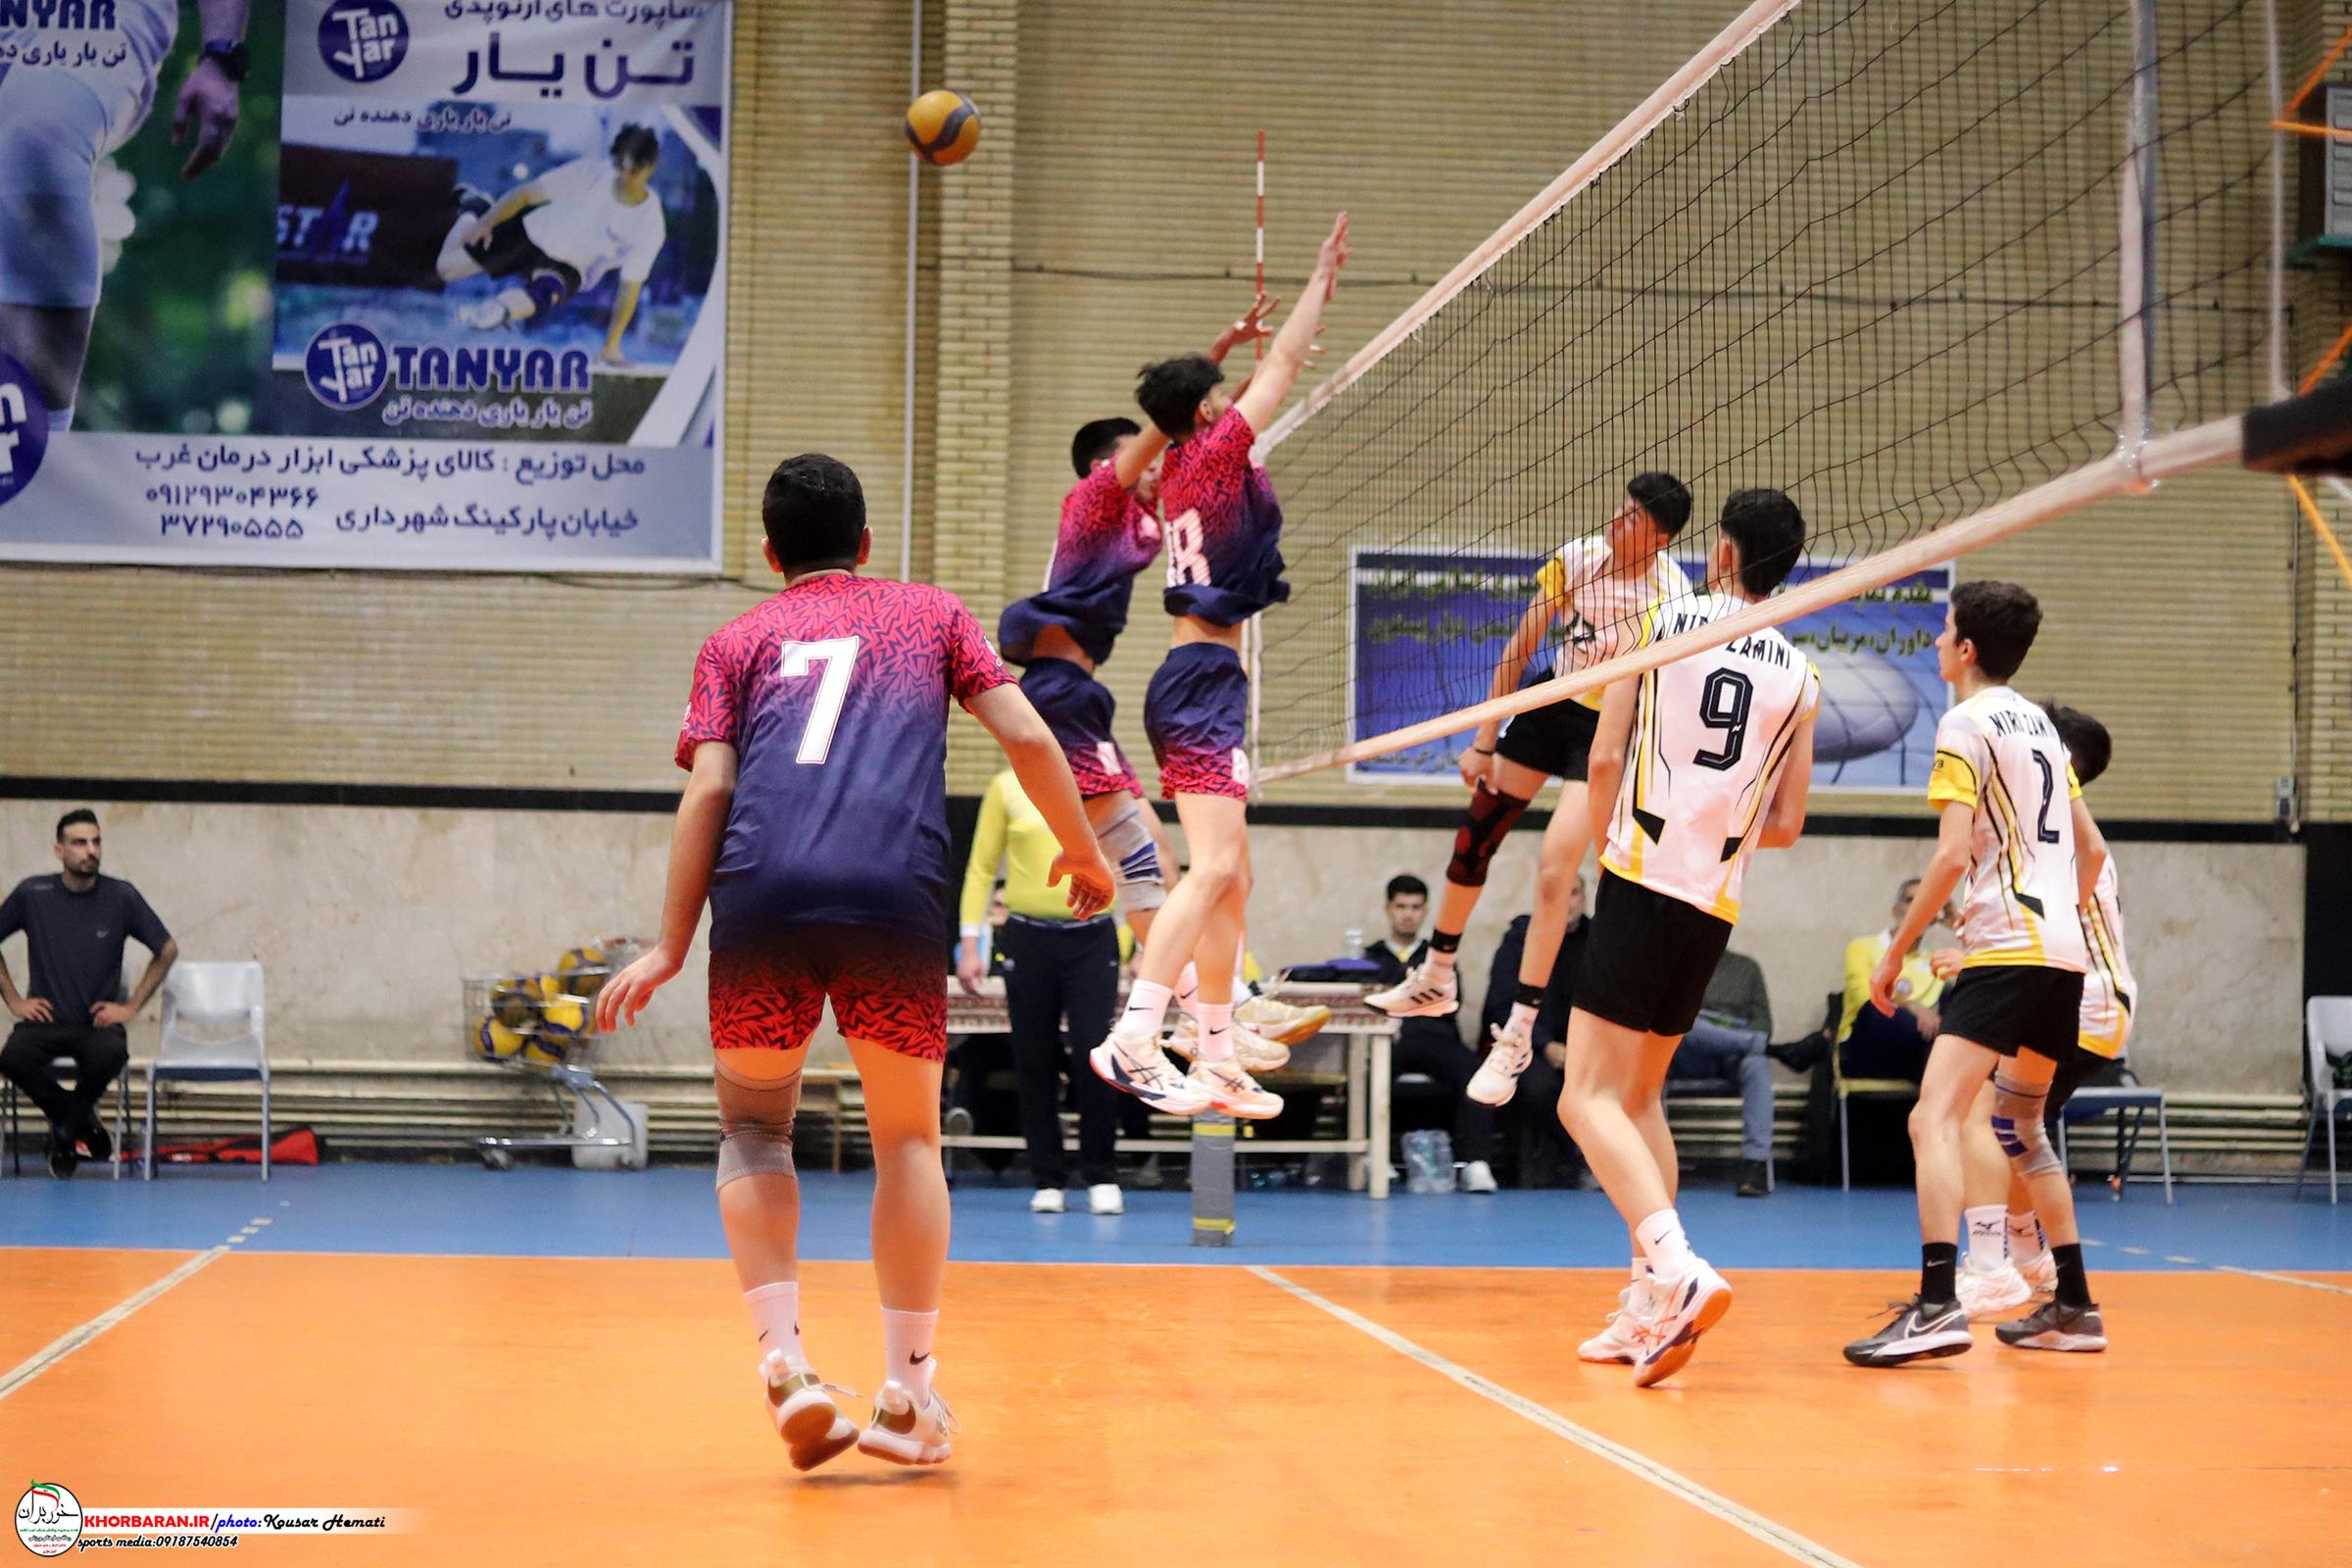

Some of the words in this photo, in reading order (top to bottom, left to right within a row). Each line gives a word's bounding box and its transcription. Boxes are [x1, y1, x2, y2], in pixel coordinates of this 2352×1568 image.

[332, 8, 399, 39] Tan
[452, 32, 564, 97] یار
[585, 39, 694, 99] تن
[318, 336, 379, 365] Tan
[393, 345, 589, 389] TANYAR
[135, 444, 191, 470] غرب
[197, 444, 270, 472] درمان
[277, 446, 332, 473] ابزار
[339, 447, 428, 481] پزشکی
[436, 448, 494, 477] کالای
[515, 452, 586, 485] توزیع
[592, 452, 645, 481] محل
[336, 504, 449, 534] شهرداری
[454, 504, 557, 540] پارکینگ
[561, 508, 638, 536] خیابان
[781, 635, 859, 764] 7
[1692, 666, 1754, 771] 9
[2031, 748, 2060, 844] 2
